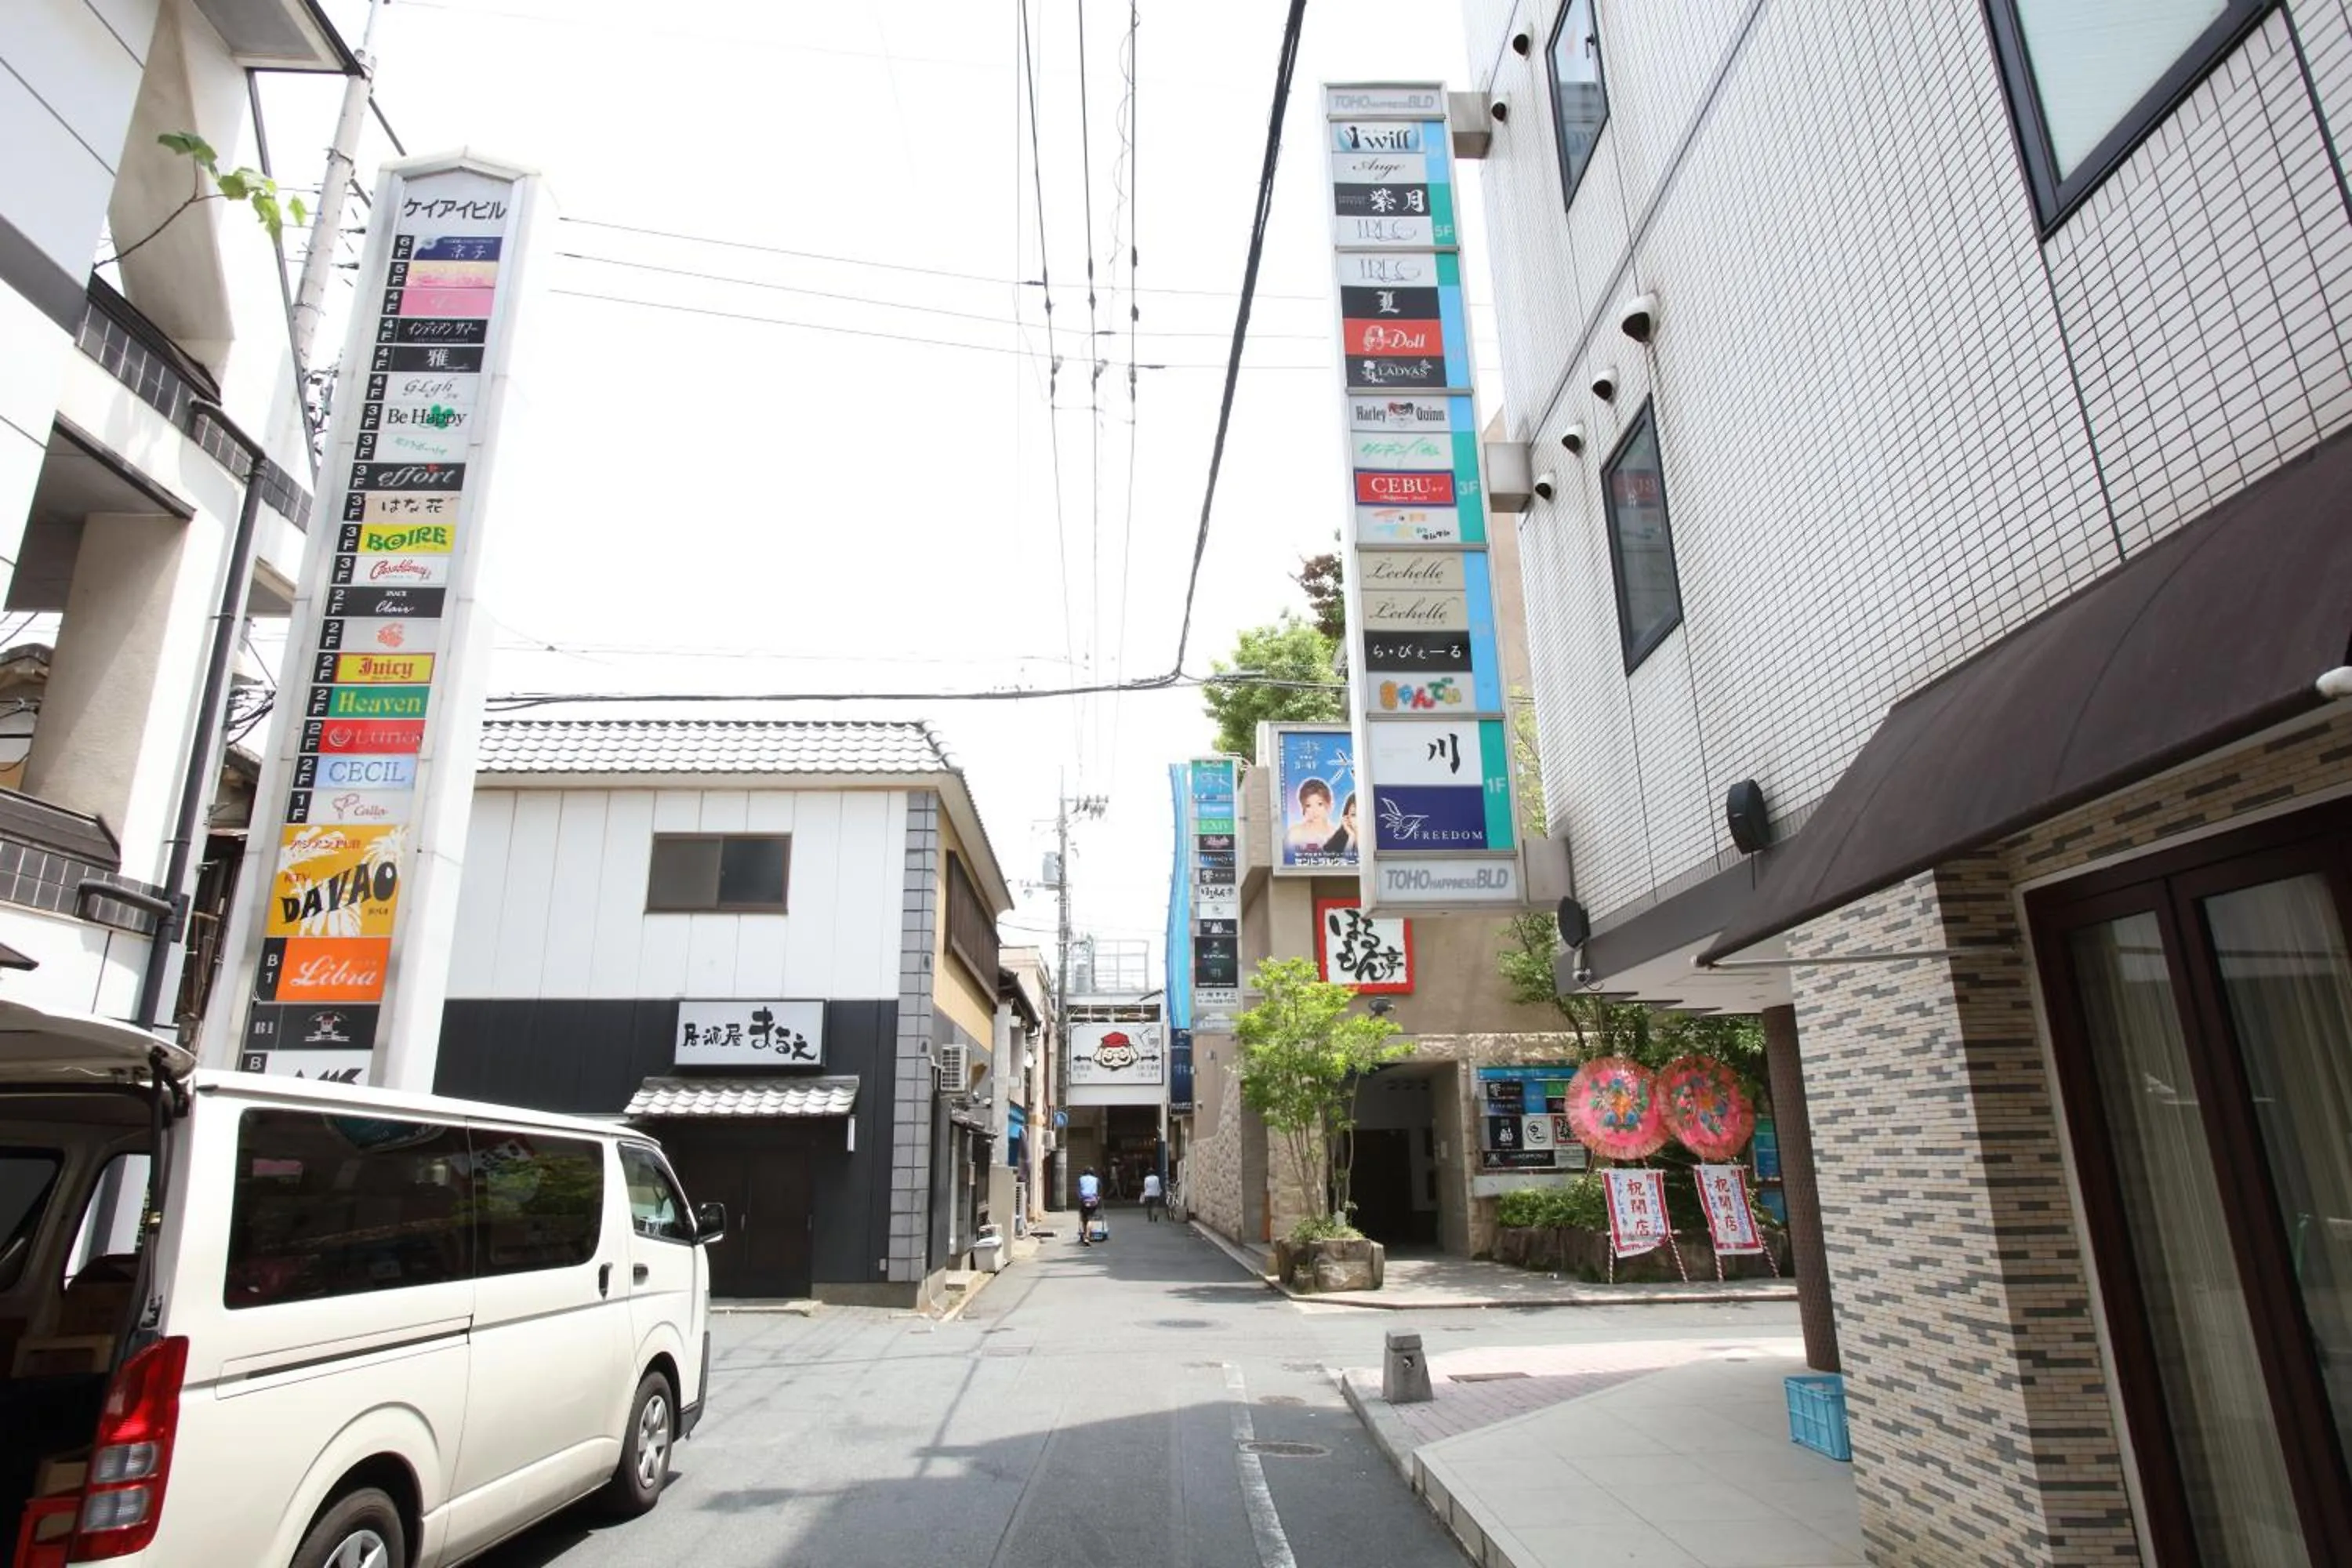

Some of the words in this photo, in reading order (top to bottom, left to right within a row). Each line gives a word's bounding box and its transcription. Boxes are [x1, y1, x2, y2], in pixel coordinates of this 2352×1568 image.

[404, 198, 508, 220] ケイアイビル
[387, 291, 399, 313] 4F
[381, 319, 393, 341] 4F
[376, 348, 388, 369] 4F
[426, 348, 450, 368] 雅
[371, 376, 383, 398] 4F
[365, 405, 378, 427] 3F
[387, 408, 408, 424] Be
[412, 408, 467, 427] Happy
[1356, 405, 1386, 423] Harley
[1416, 406, 1445, 422] Quinn
[360, 434, 372, 457] 3F
[354, 465, 367, 488] 3F
[378, 465, 456, 487] effort
[1371, 477, 1431, 494] CEBU
[1458, 480, 1479, 496] 3F
[348, 495, 362, 519] 3F
[343, 526, 357, 547] 3F
[337, 558, 351, 582] 3F
[331, 589, 345, 614] 2F
[325, 622, 339, 647] 2F
[319, 655, 333, 681] 2F
[358, 657, 415, 679] Juicy
[313, 688, 328, 714] 2F
[338, 691, 422, 713] Heaven
[305, 723, 322, 750] 2F
[1427, 732, 1461, 775] 川
[299, 758, 313, 786] 2F
[328, 761, 406, 783] CECIL
[1485, 777, 1507, 794] 1F
[293, 793, 306, 821] 1F
[1413, 830, 1484, 840] FREEDOM
[1386, 869, 1430, 891] TOHO
[1476, 868, 1508, 889] BLD
[279, 861, 397, 924] DAVAO
[265, 953, 278, 985] B1
[289, 954, 379, 988] Libra
[683, 1022, 743, 1047] 居酒屋
[1626, 1178, 1651, 1236] 祝開店
